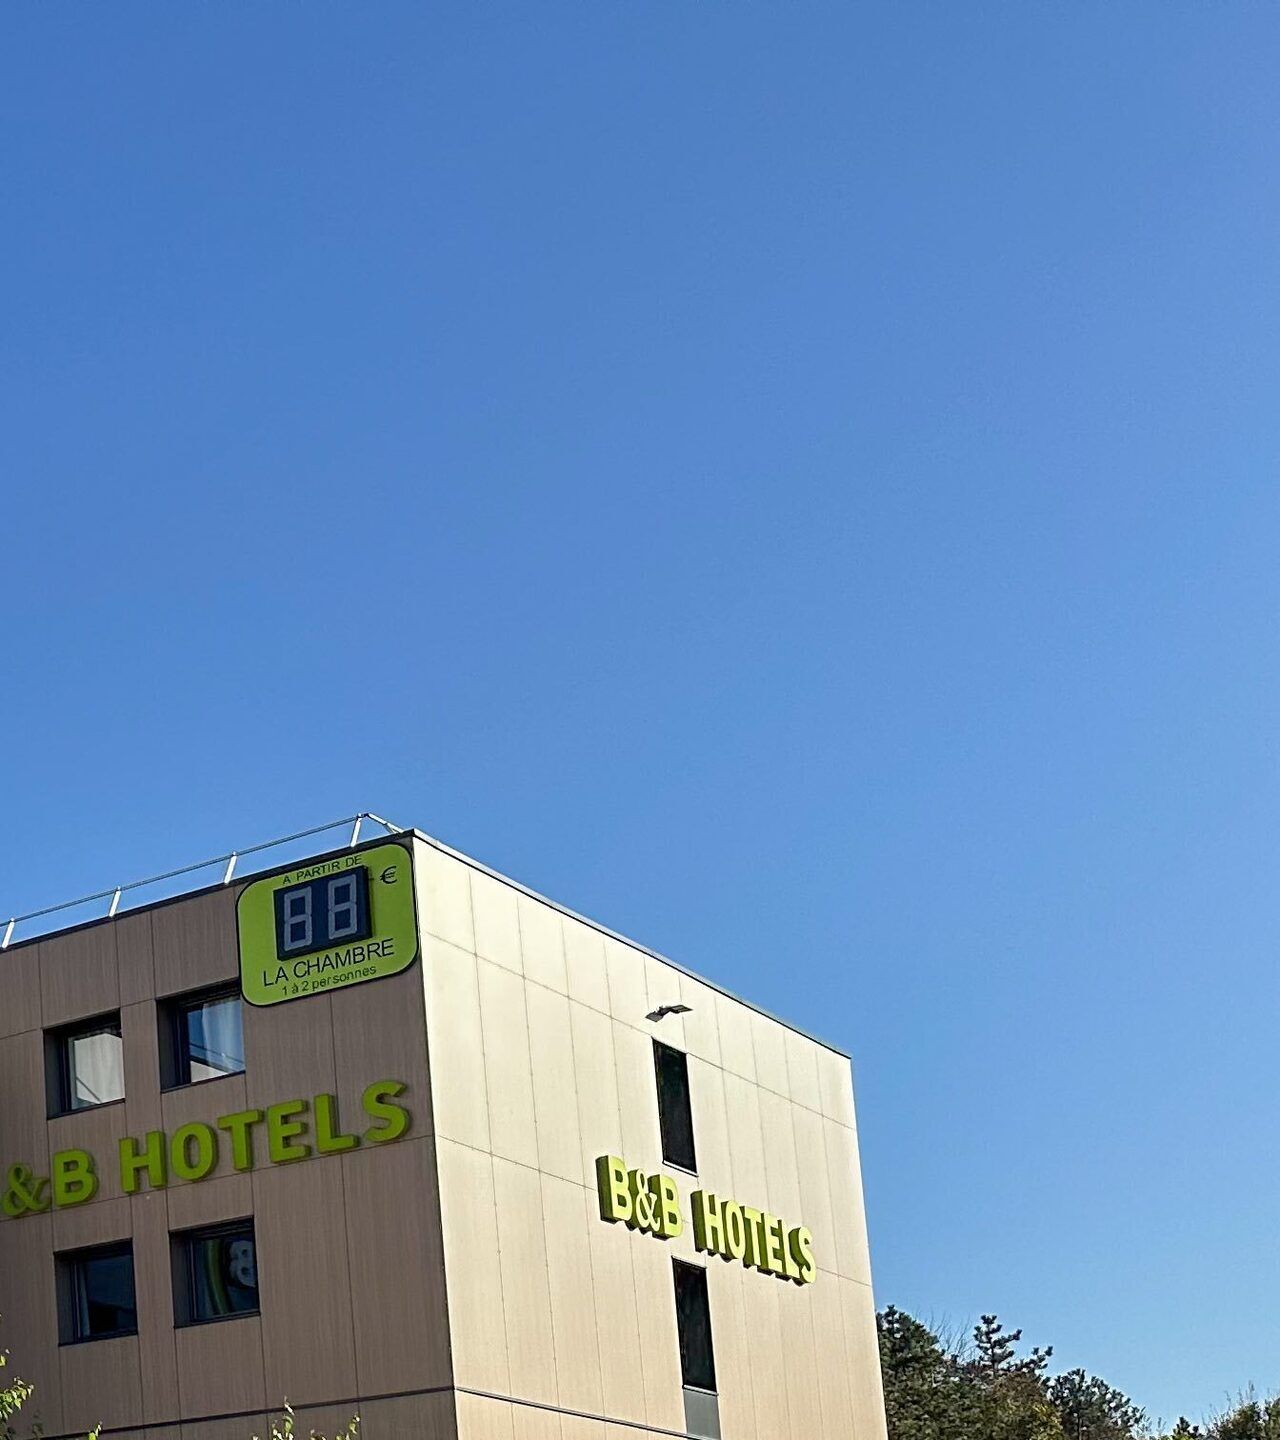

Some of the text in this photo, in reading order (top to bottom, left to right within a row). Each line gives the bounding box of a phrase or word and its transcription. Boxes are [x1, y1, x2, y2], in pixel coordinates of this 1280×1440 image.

[296, 861, 340, 882] PARTIR
[346, 855, 362, 868] DE
[263, 938, 395, 987] LA CHAMBRE
[282, 966, 377, 996] 1 à 2 personnes
[119, 1079, 412, 1195] HOTELS
[596, 1154, 816, 1287] B&B HOTELS
